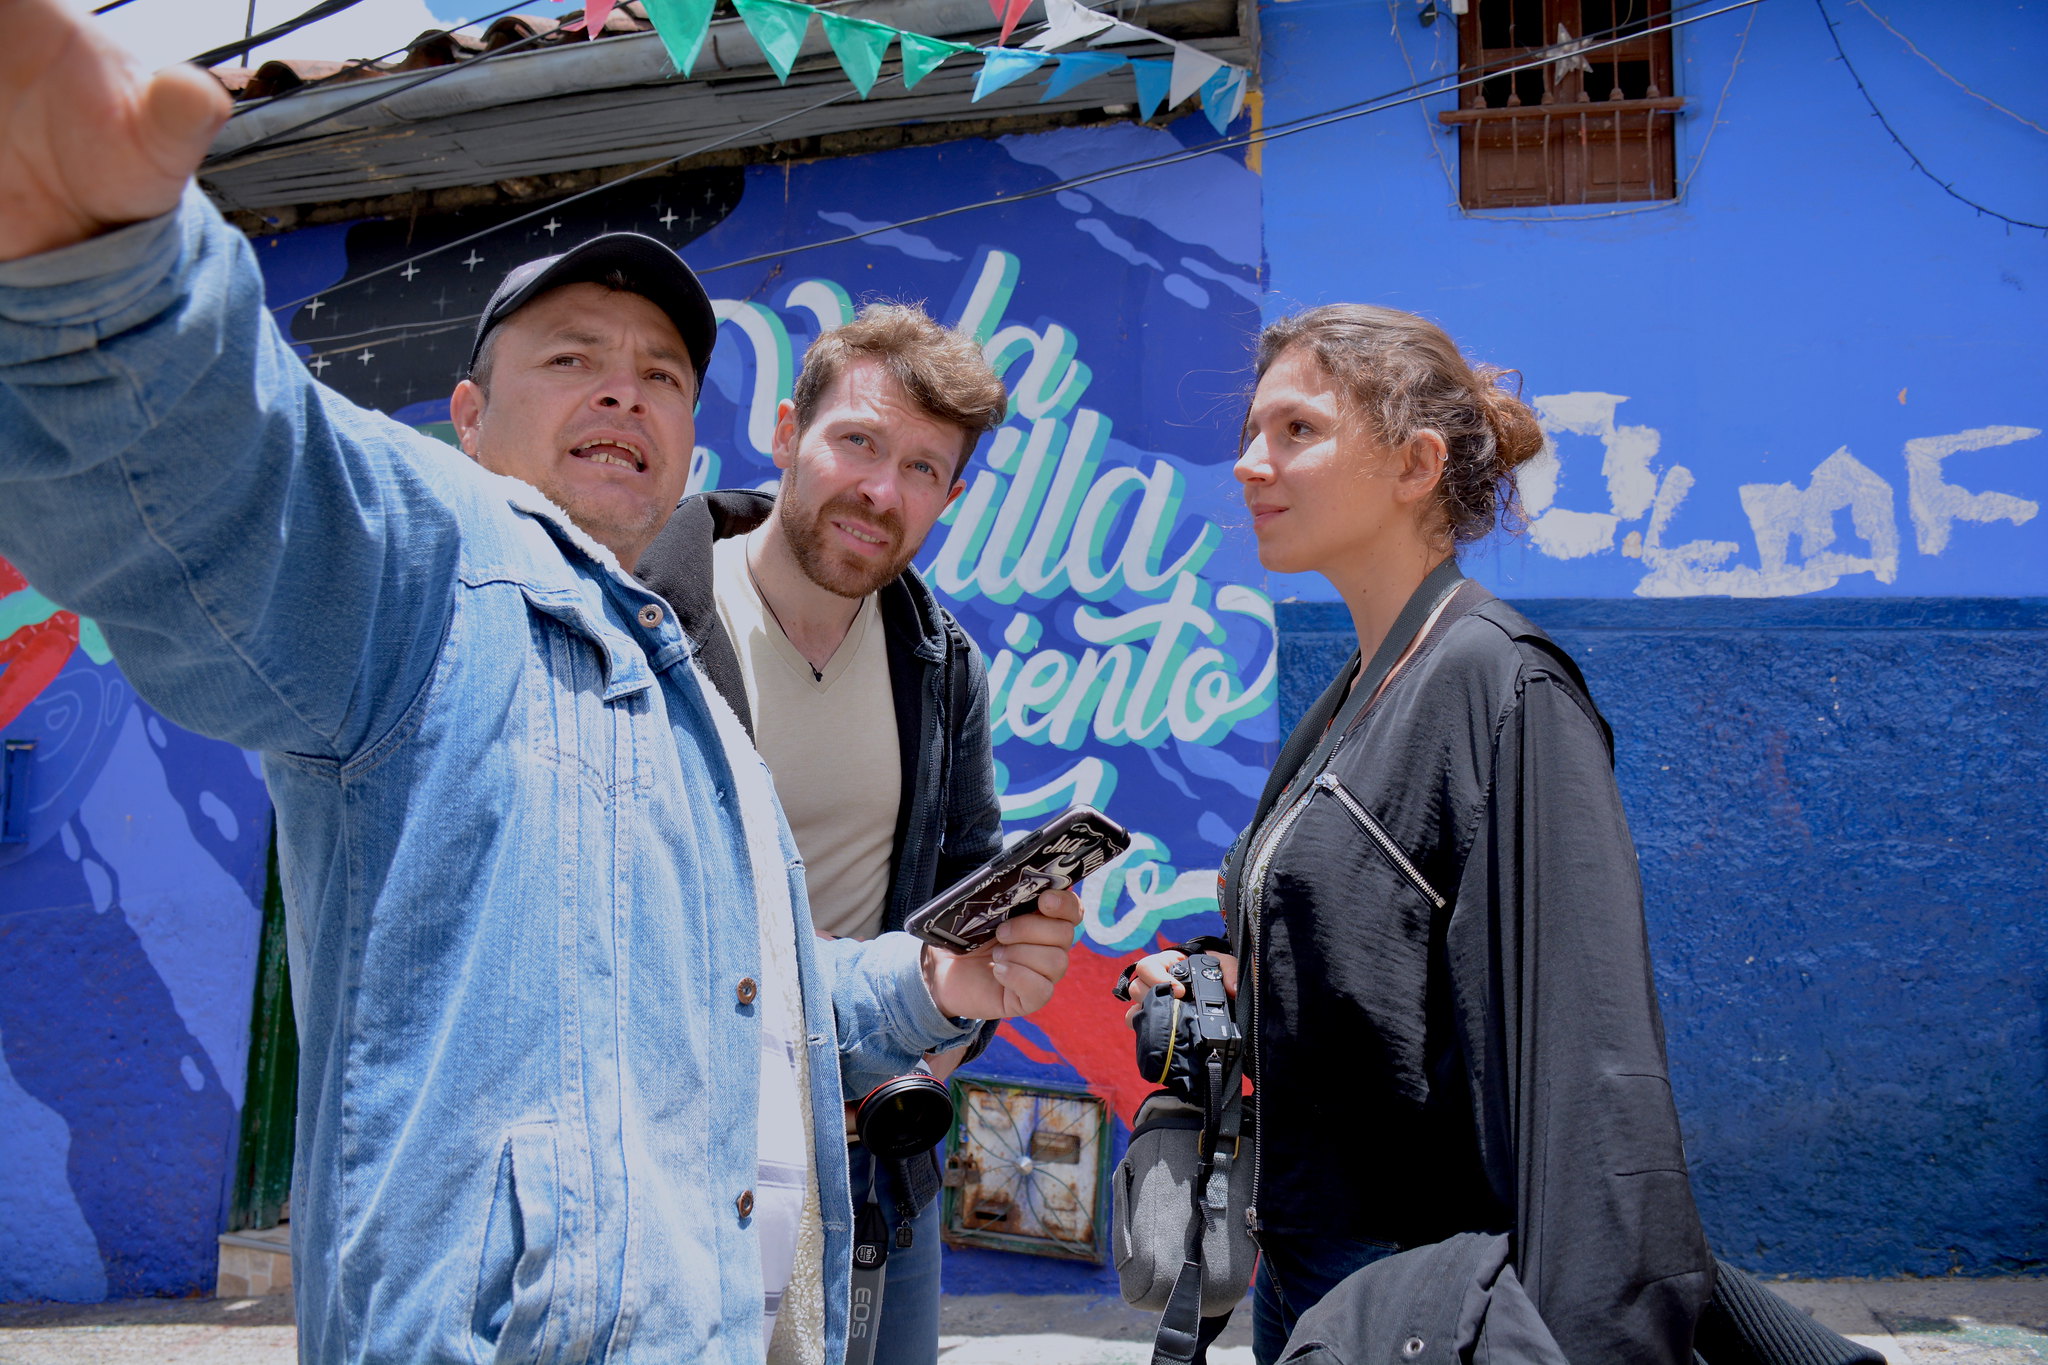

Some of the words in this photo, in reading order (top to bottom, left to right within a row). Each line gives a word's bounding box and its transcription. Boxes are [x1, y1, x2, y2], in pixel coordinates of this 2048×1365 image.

[922, 406, 1219, 604] illa
[988, 569, 1279, 750] iento
[852, 1287, 871, 1338] EOS
